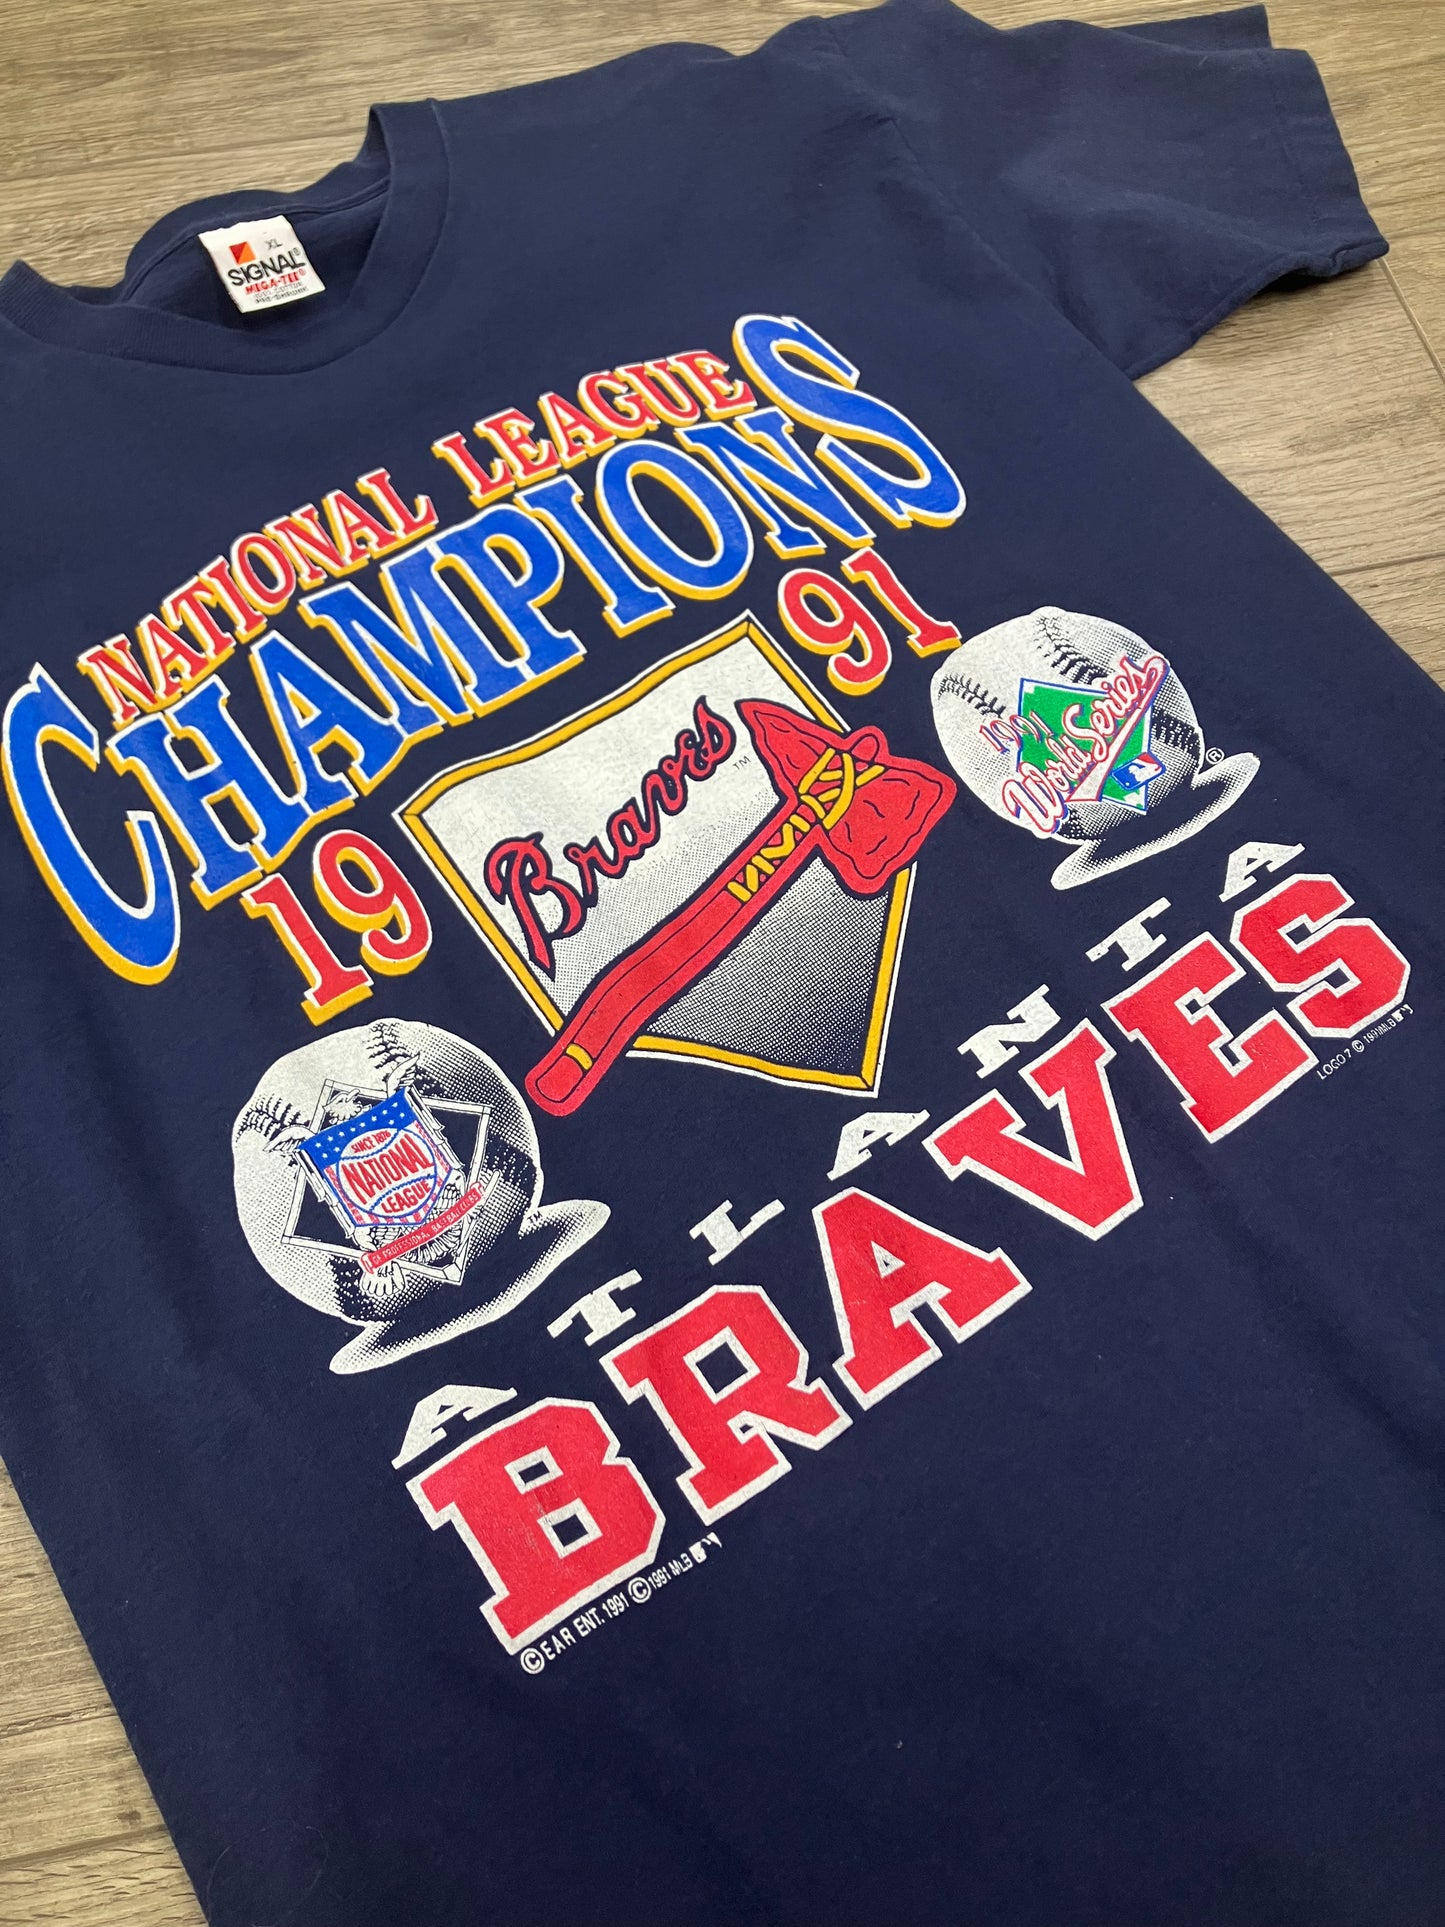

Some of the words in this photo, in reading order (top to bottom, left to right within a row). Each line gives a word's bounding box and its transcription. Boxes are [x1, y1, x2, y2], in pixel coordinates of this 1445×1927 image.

[265, 238, 282, 249] XL
[77, 468, 438, 730] NATIONAL
[432, 351, 758, 503] LEAGUE
[0, 313, 967, 987] CHAMPIONS
[979, 711, 1053, 755] 1991
[1002, 732, 1092, 834] World
[1063, 655, 1164, 770] Series
[241, 830, 432, 1020] 19
[777, 550, 961, 696] 91
[483, 694, 736, 981] Braves
[1316, 1054, 1346, 1080] LOGO
[342, 1133, 435, 1203] NATIONAL
[351, 1136, 375, 1154] SINCE
[381, 1182, 434, 1215] LEAGUE
[383, 1231, 431, 1260] PROFESSIONAL
[431, 1209, 462, 1233] BASEBALL
[405, 872, 1411, 1654] BRAVES
[573, 1609, 605, 1638] ENT.
[602, 1591, 631, 1619] 1991
[668, 1553, 694, 1577] MLB
